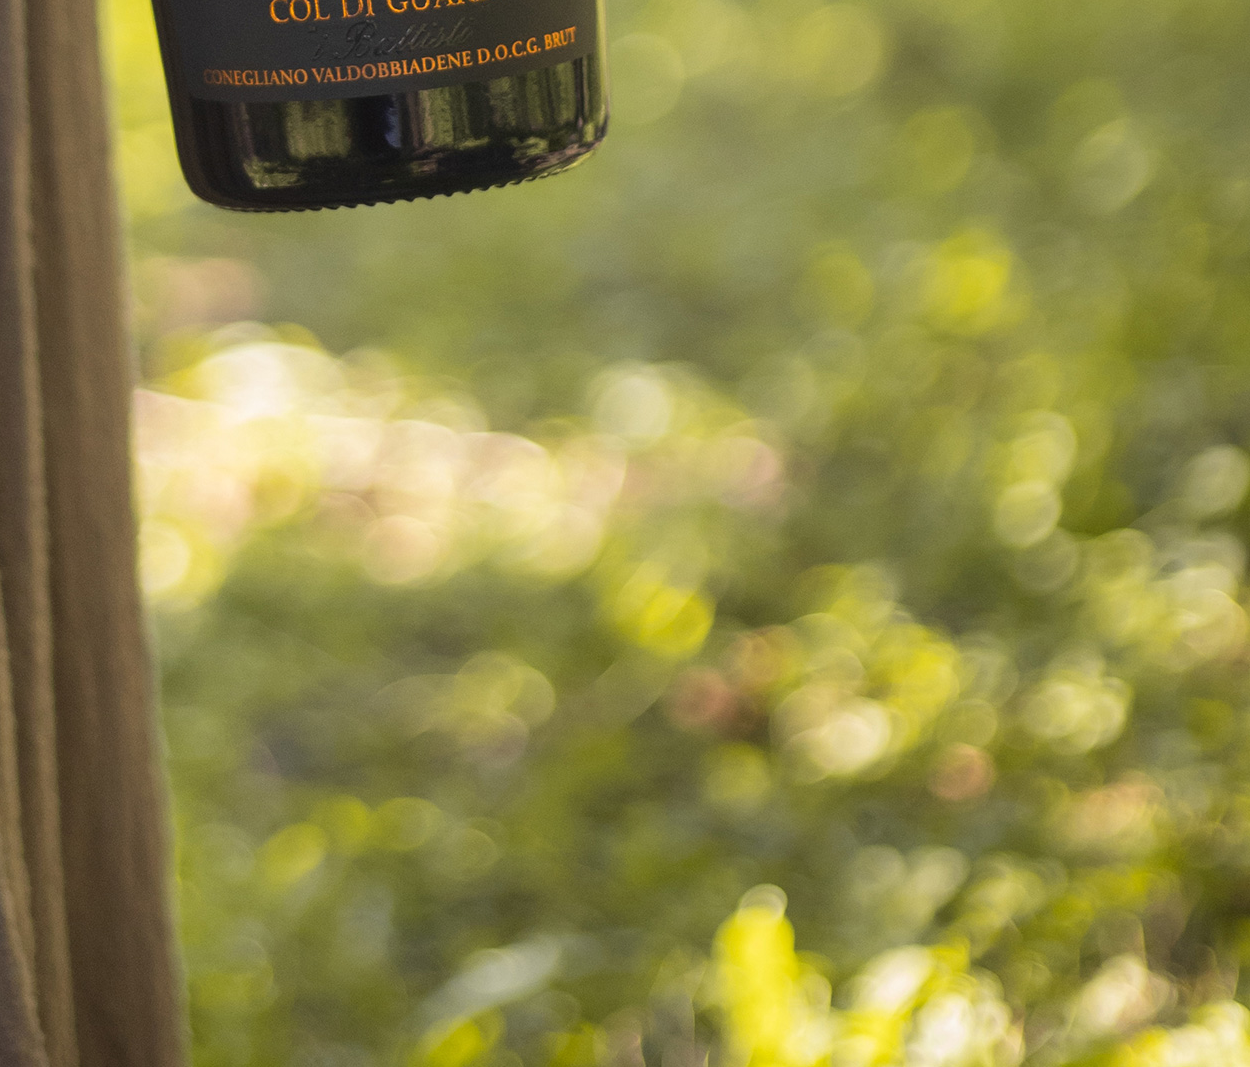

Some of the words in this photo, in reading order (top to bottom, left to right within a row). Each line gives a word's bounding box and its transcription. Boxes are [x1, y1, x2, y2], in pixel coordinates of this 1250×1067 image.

[204, 68, 309, 85] CONEGLIANO
[311, 50, 473, 83] VALDOBBIADENE
[477, 37, 541, 65] D.O.C.G.
[544, 26, 576, 50] BRUT
